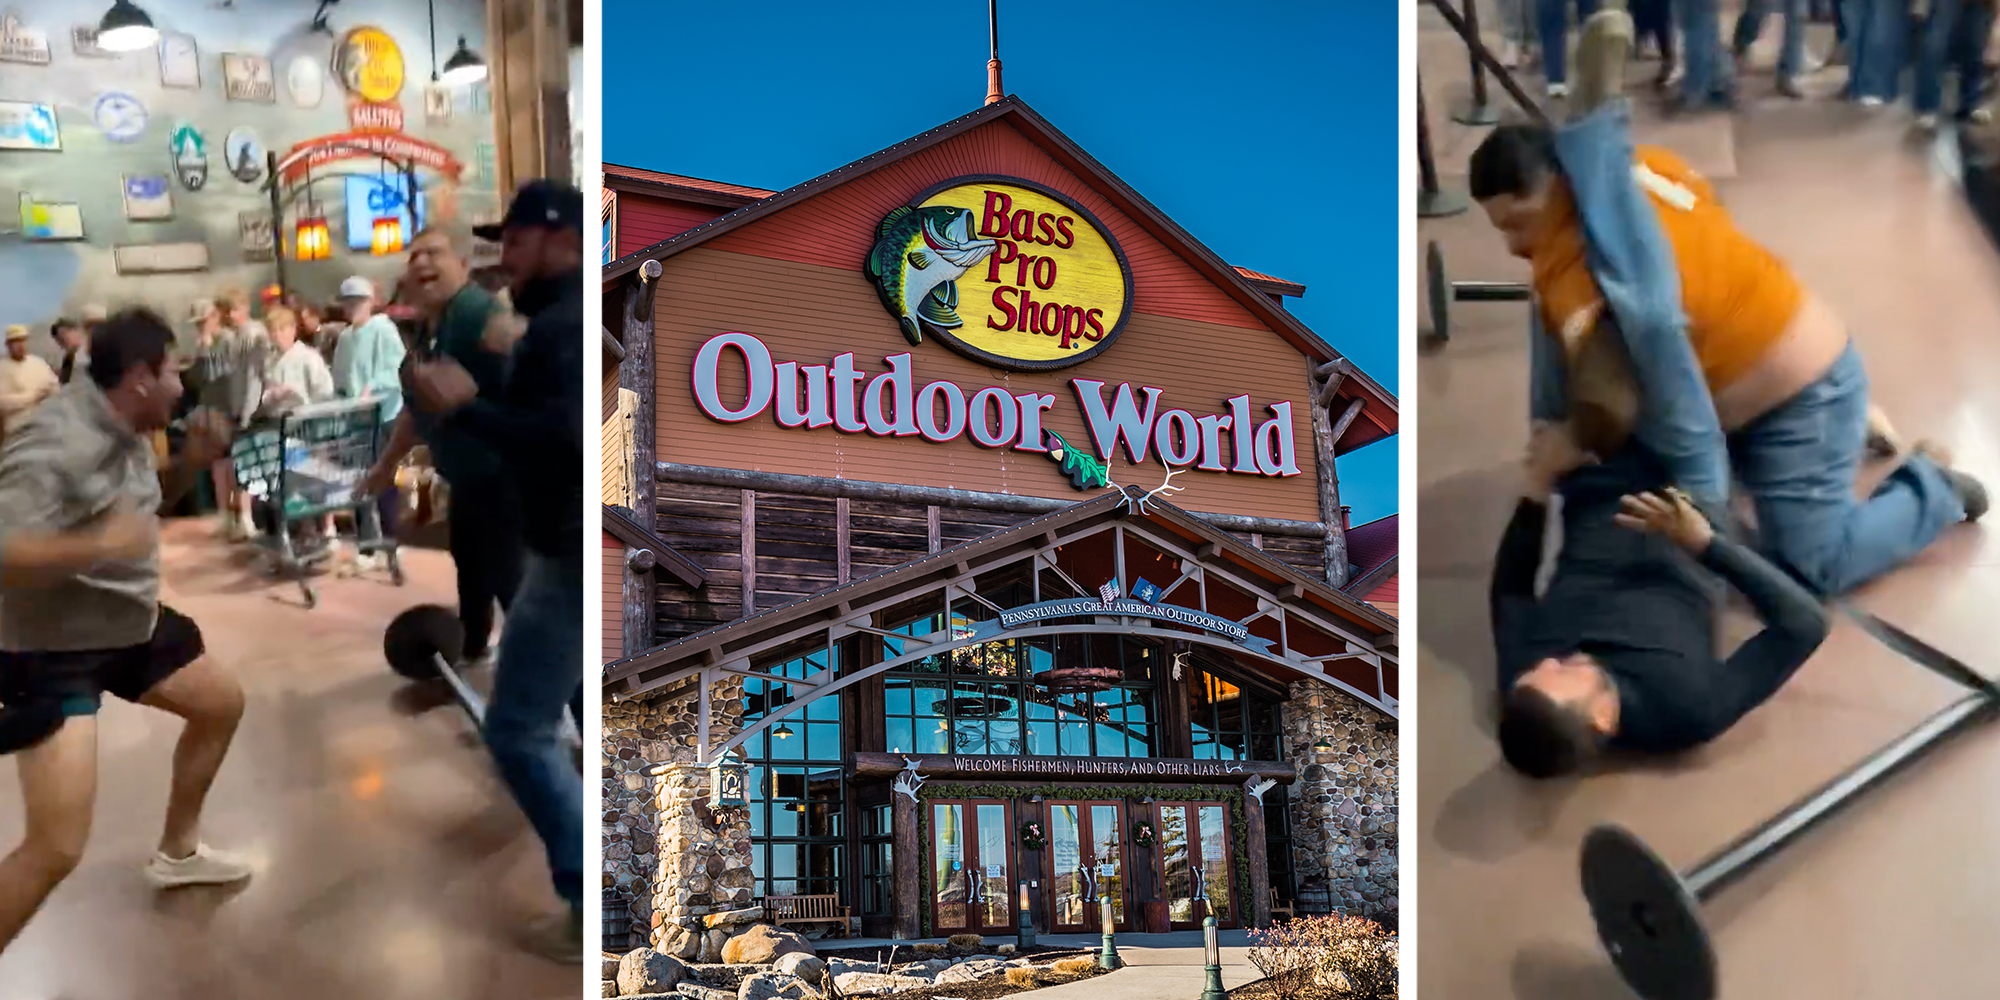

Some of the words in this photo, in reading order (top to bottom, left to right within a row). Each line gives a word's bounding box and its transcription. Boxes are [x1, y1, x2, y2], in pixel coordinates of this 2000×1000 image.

[977, 190, 1075, 249] Bass
[985, 239, 1057, 290] Pro
[987, 286, 1104, 349] Shops
[691, 332, 1056, 454] Outdoor
[1068, 378, 1302, 477] World
[1001, 602, 1081, 625] PENNSYLVANIA'S
[1083, 601, 1113, 612] GREAT
[1114, 603, 1165, 617] AMERICAN
[1166, 608, 1216, 628] OUTDOOR
[1217, 621, 1247, 639] STORE
[954, 757, 1007, 772] WELCOME
[1012, 759, 1074, 775] FISHERMEN,
[1077, 760, 1128, 776] HUNTERS,
[1130, 762, 1153, 774] AND
[1156, 762, 1190, 775] OTHER
[1193, 762, 1220, 775] LIARS
